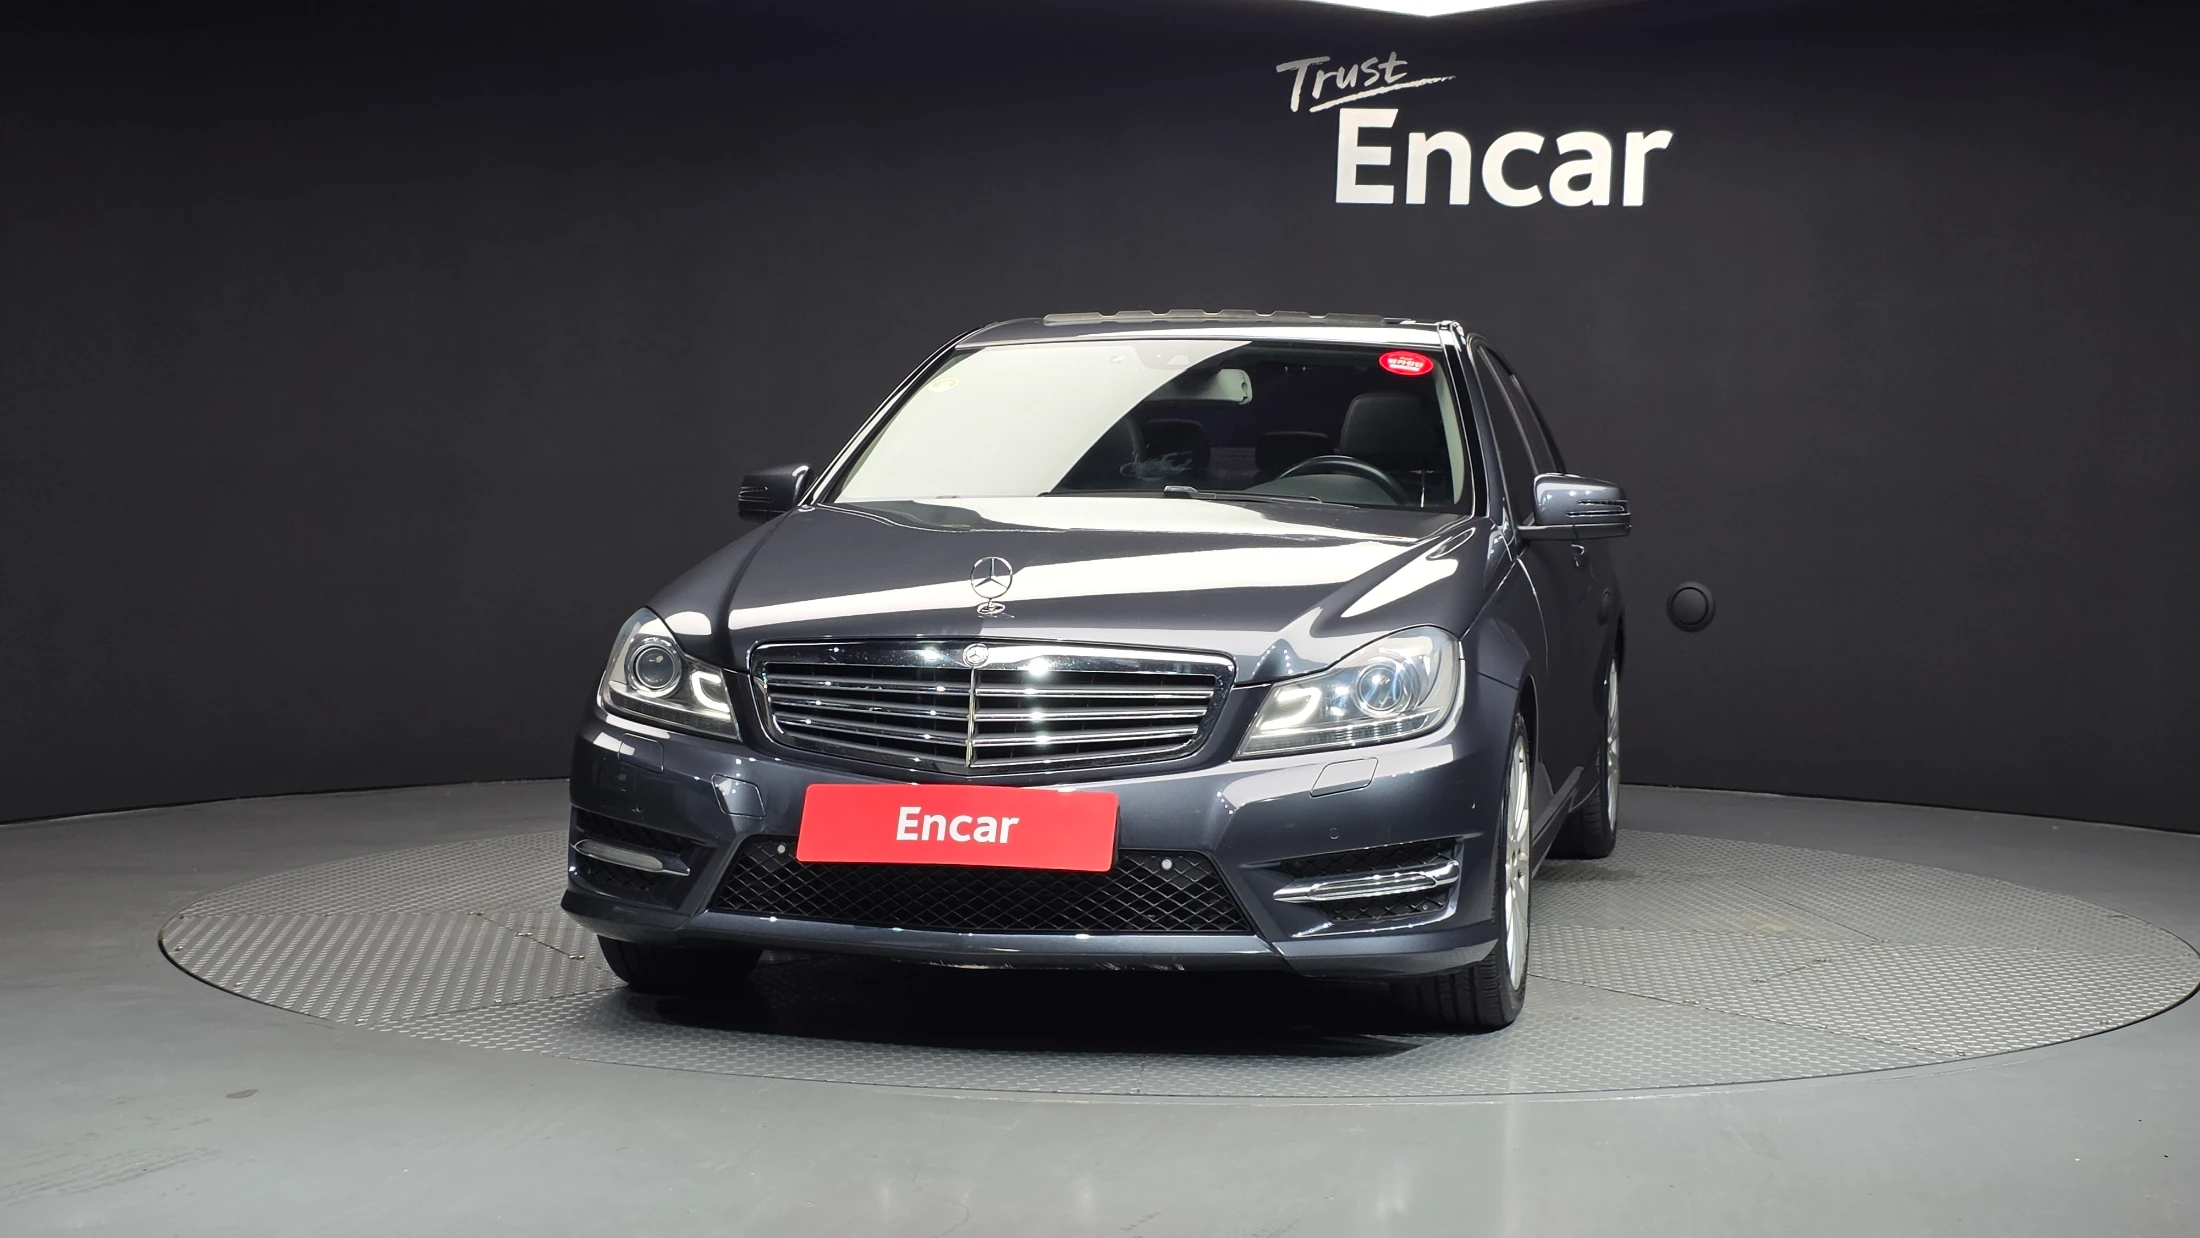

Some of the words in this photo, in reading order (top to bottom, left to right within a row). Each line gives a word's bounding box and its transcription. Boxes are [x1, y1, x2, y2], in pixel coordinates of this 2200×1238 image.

[1276, 51, 1408, 113] Trust
[1335, 108, 1674, 207] Encar
[896, 806, 1020, 844] Encar
